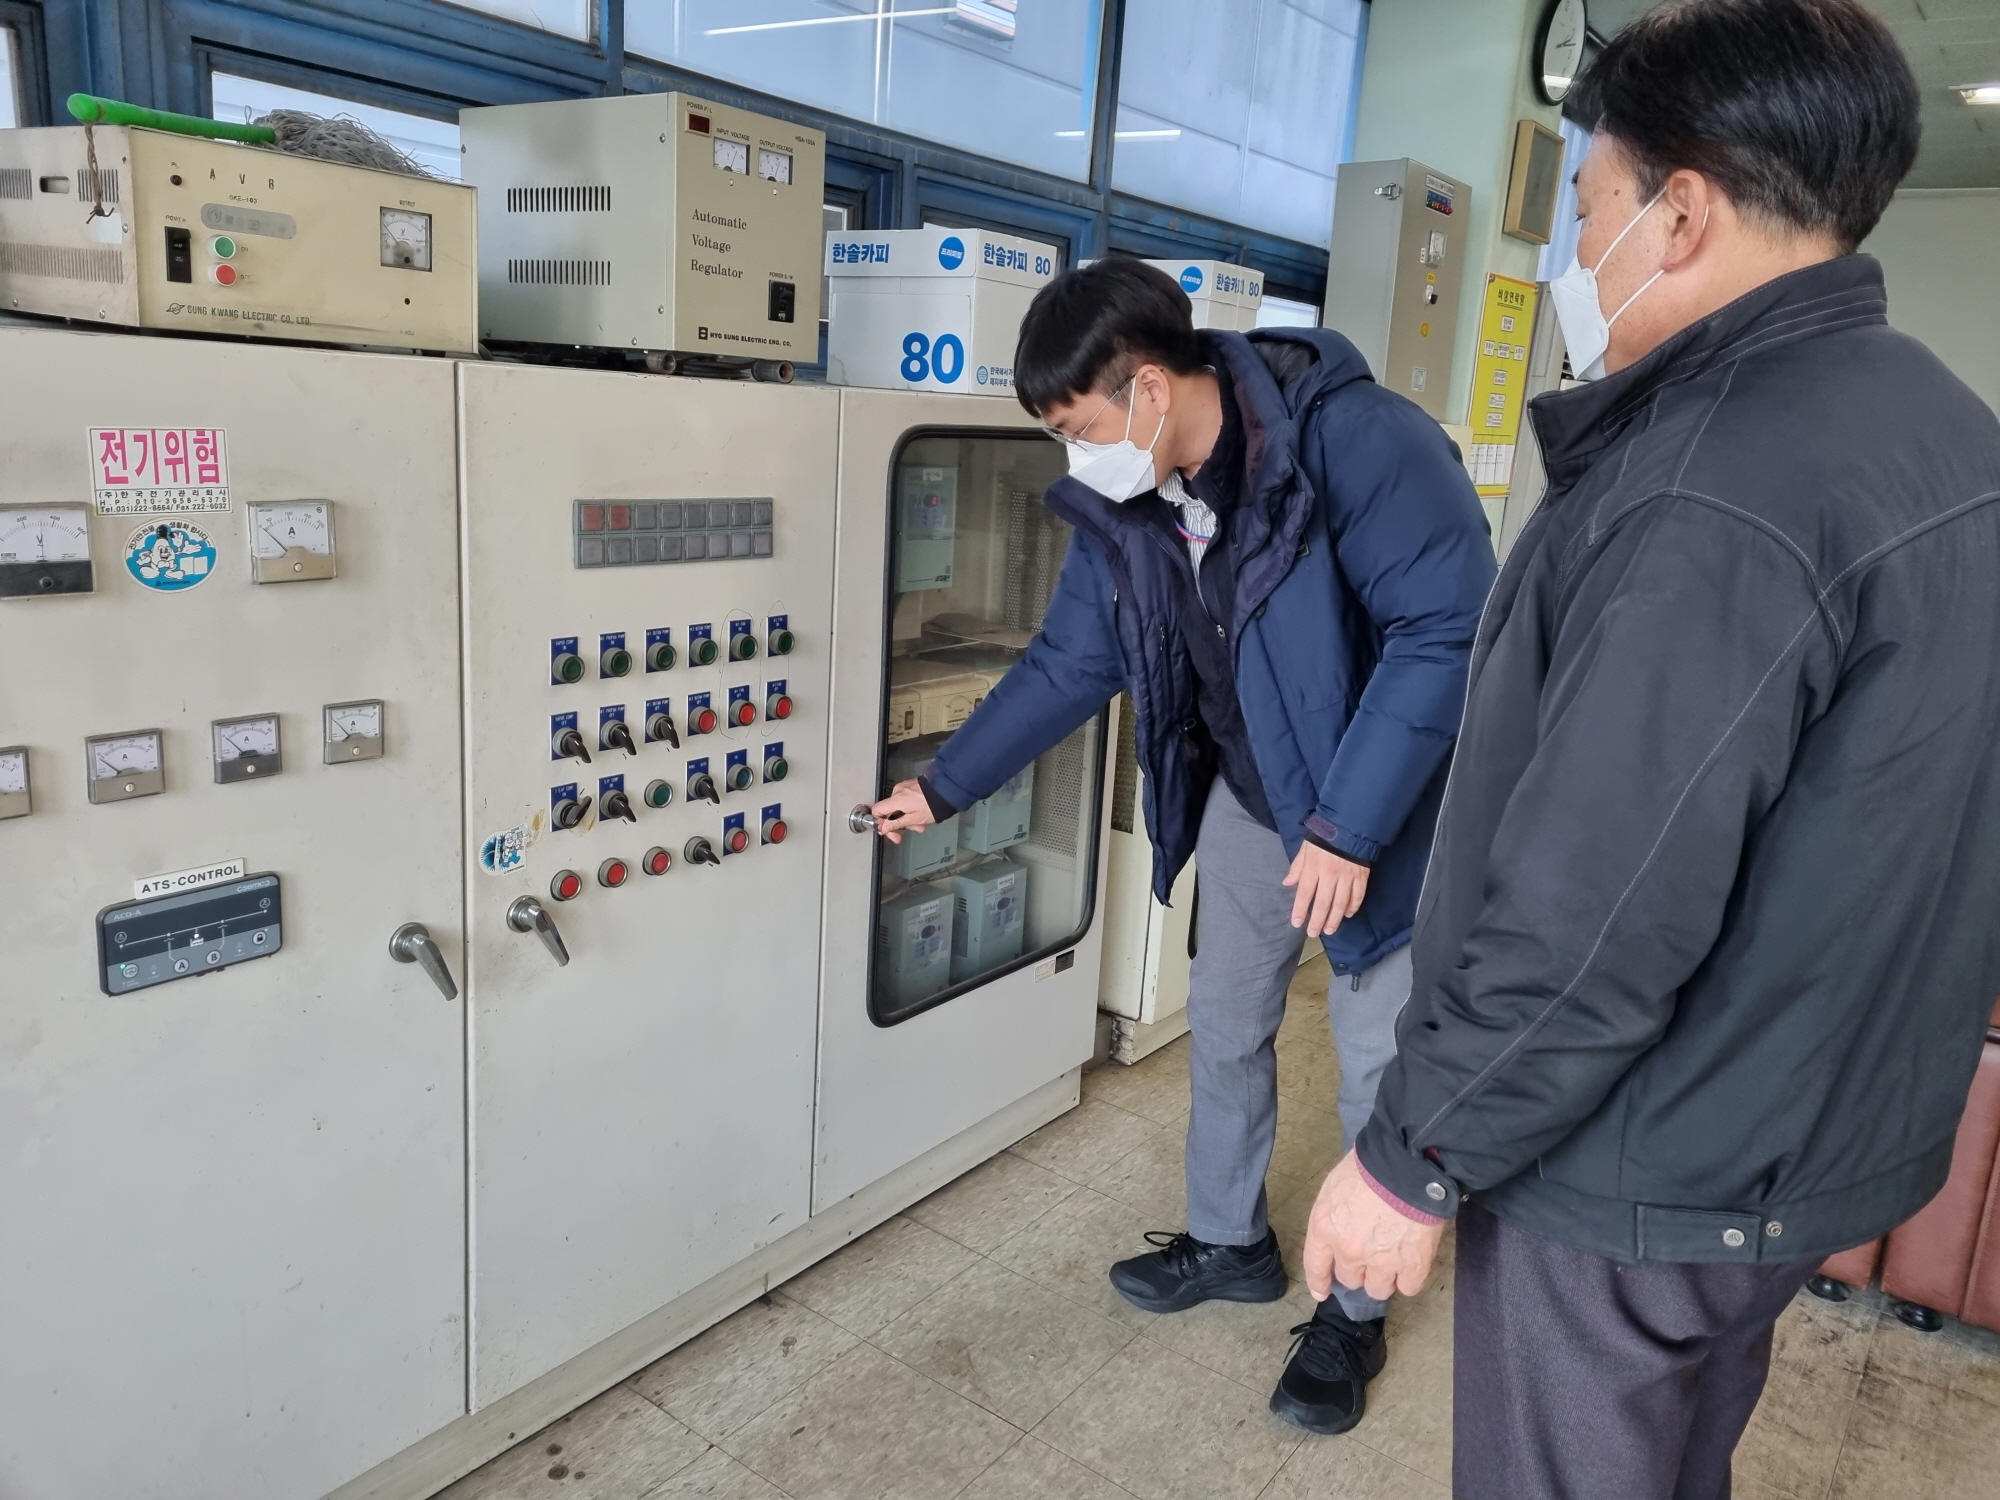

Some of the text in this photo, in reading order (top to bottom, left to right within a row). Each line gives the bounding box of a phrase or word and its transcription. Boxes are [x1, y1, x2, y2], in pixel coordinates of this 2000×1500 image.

[687, 101, 704, 112] POWER
[730, 131, 750, 142] VOLTAGE
[760, 139, 794, 153] OUTPUT VOLTAGE
[210, 168, 275, 190] A V R
[692, 208, 747, 230] Automatic
[692, 234, 731, 254] Voltage
[832, 242, 890, 264] 한솔카피
[690, 259, 744, 278] Regulator
[984, 242, 1051, 276] 한솔카피 80
[1248, 282, 1260, 296] 80
[187, 304, 208, 316] SUNG
[211, 307, 239, 319] KWANG
[242, 311, 278, 323] ELECTRIC
[724, 334, 740, 342] SUNG
[741, 336, 768, 344] ELECTRIC
[900, 332, 964, 384] 80
[99, 429, 220, 485] 전기위험
[36, 534, 43, 544] V
[288, 526, 296, 536] A
[142, 864, 240, 894] ATS-CONTROL
[178, 959, 186, 970] A
[211, 953, 217, 962] B
